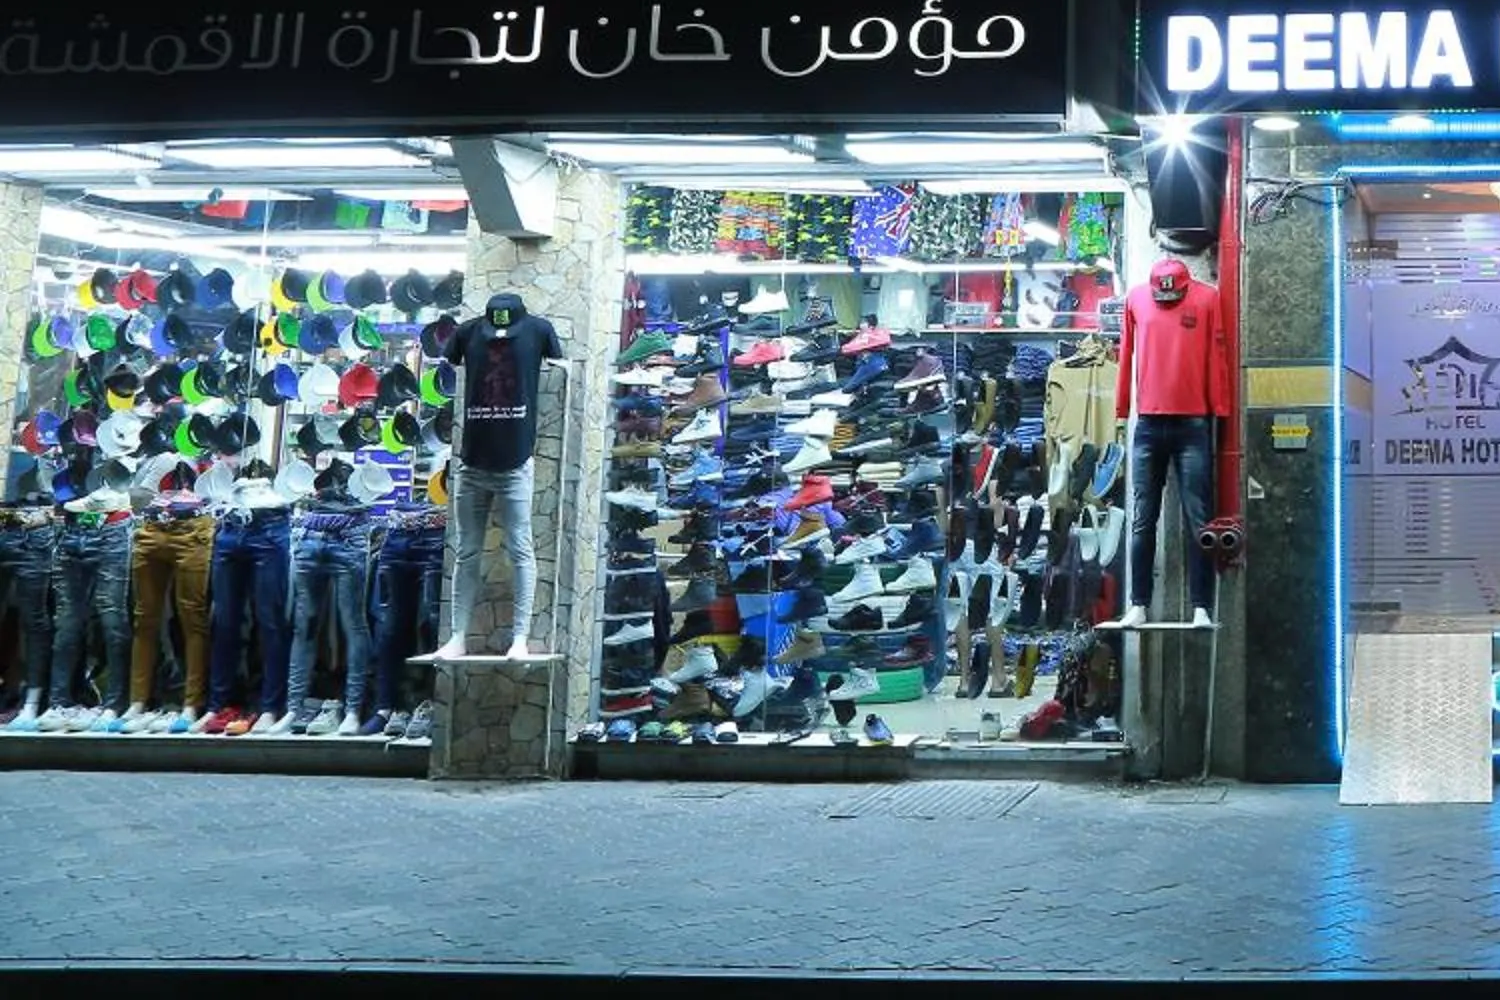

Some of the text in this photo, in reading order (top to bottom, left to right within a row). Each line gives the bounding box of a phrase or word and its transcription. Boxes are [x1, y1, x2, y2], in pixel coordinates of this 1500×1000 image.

[0, 11, 305, 76] الاقمشة
[328, 6, 545, 83] لتجارة
[568, 3, 731, 78] خان
[1167, 11, 1474, 92] DEEMA
[1385, 438, 1455, 465] DEEMA
